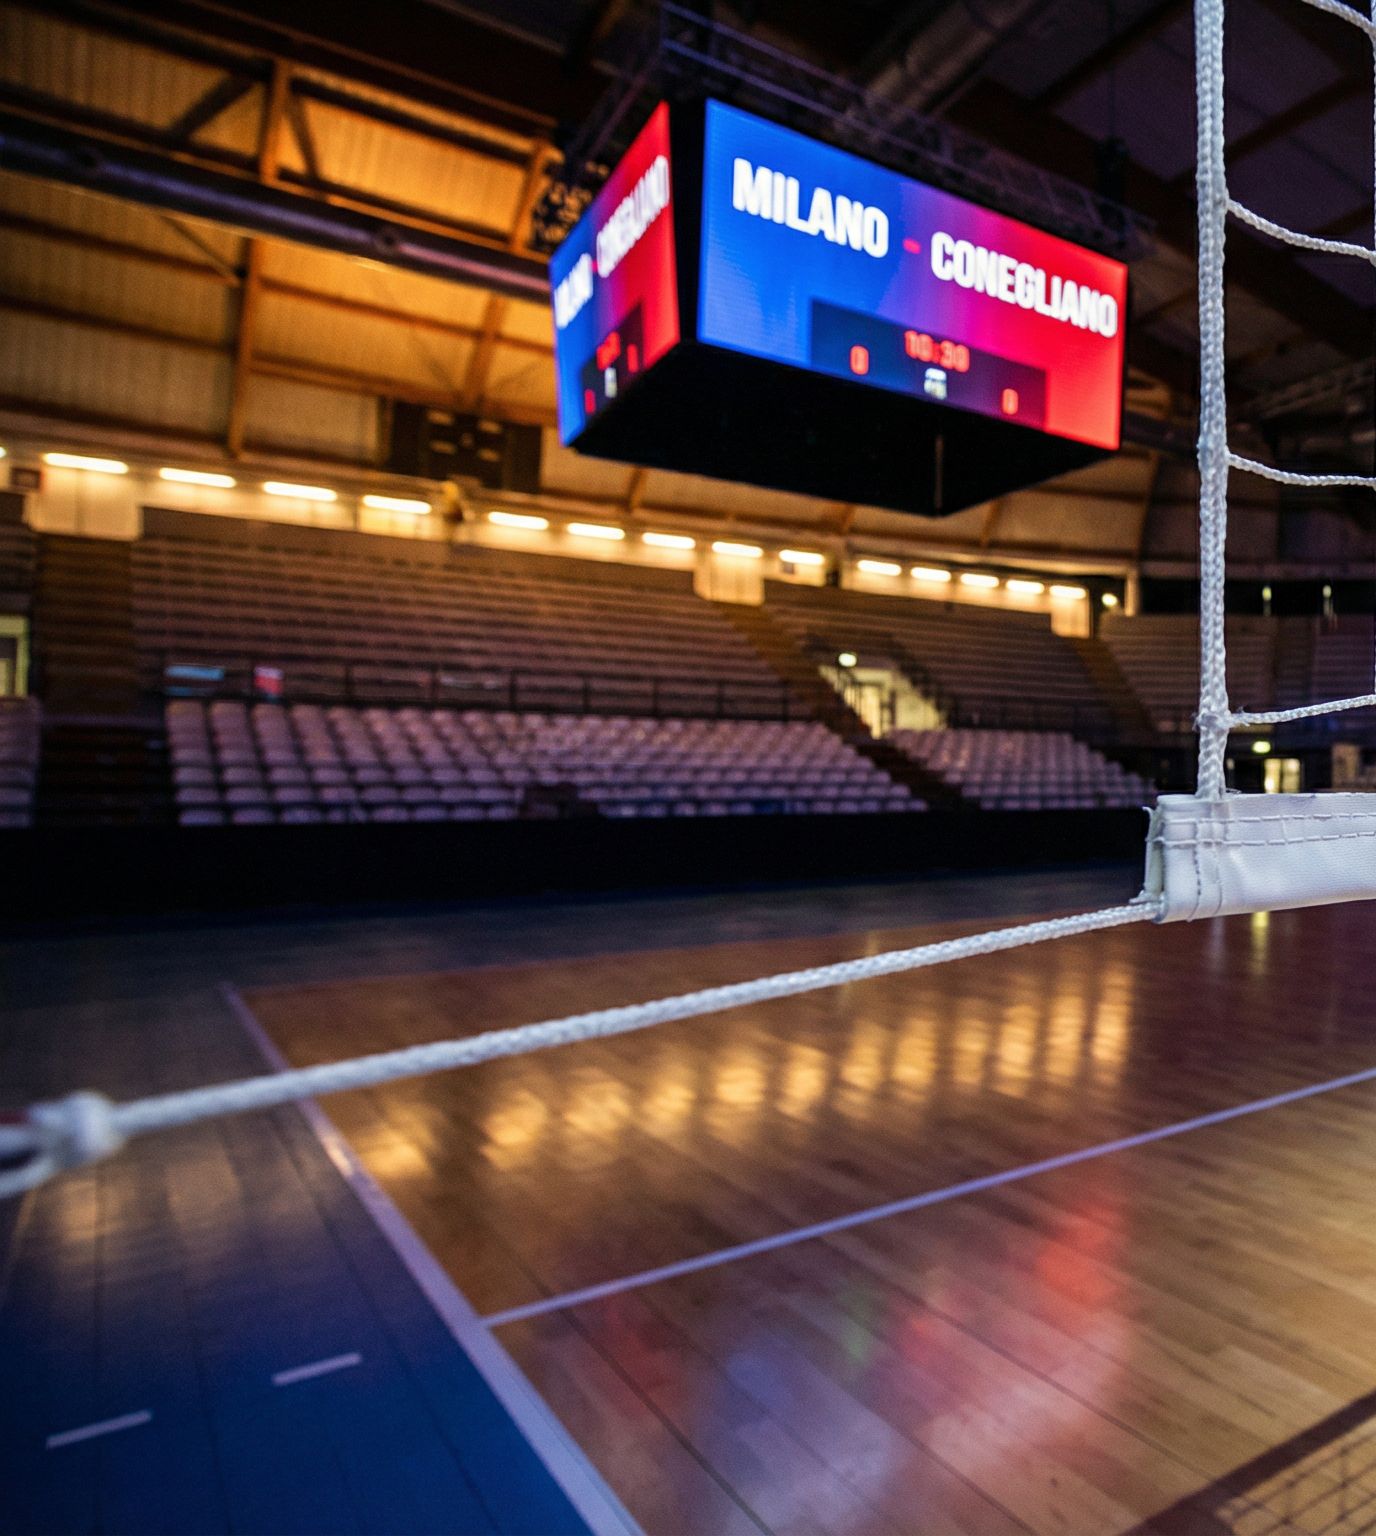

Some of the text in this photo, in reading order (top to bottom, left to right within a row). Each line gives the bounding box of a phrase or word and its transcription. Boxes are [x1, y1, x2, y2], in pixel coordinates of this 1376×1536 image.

[733, 157, 889, 258] MILANO
[931, 231, 1118, 338] CONEGLIANO
[850, 346, 869, 375] 0
